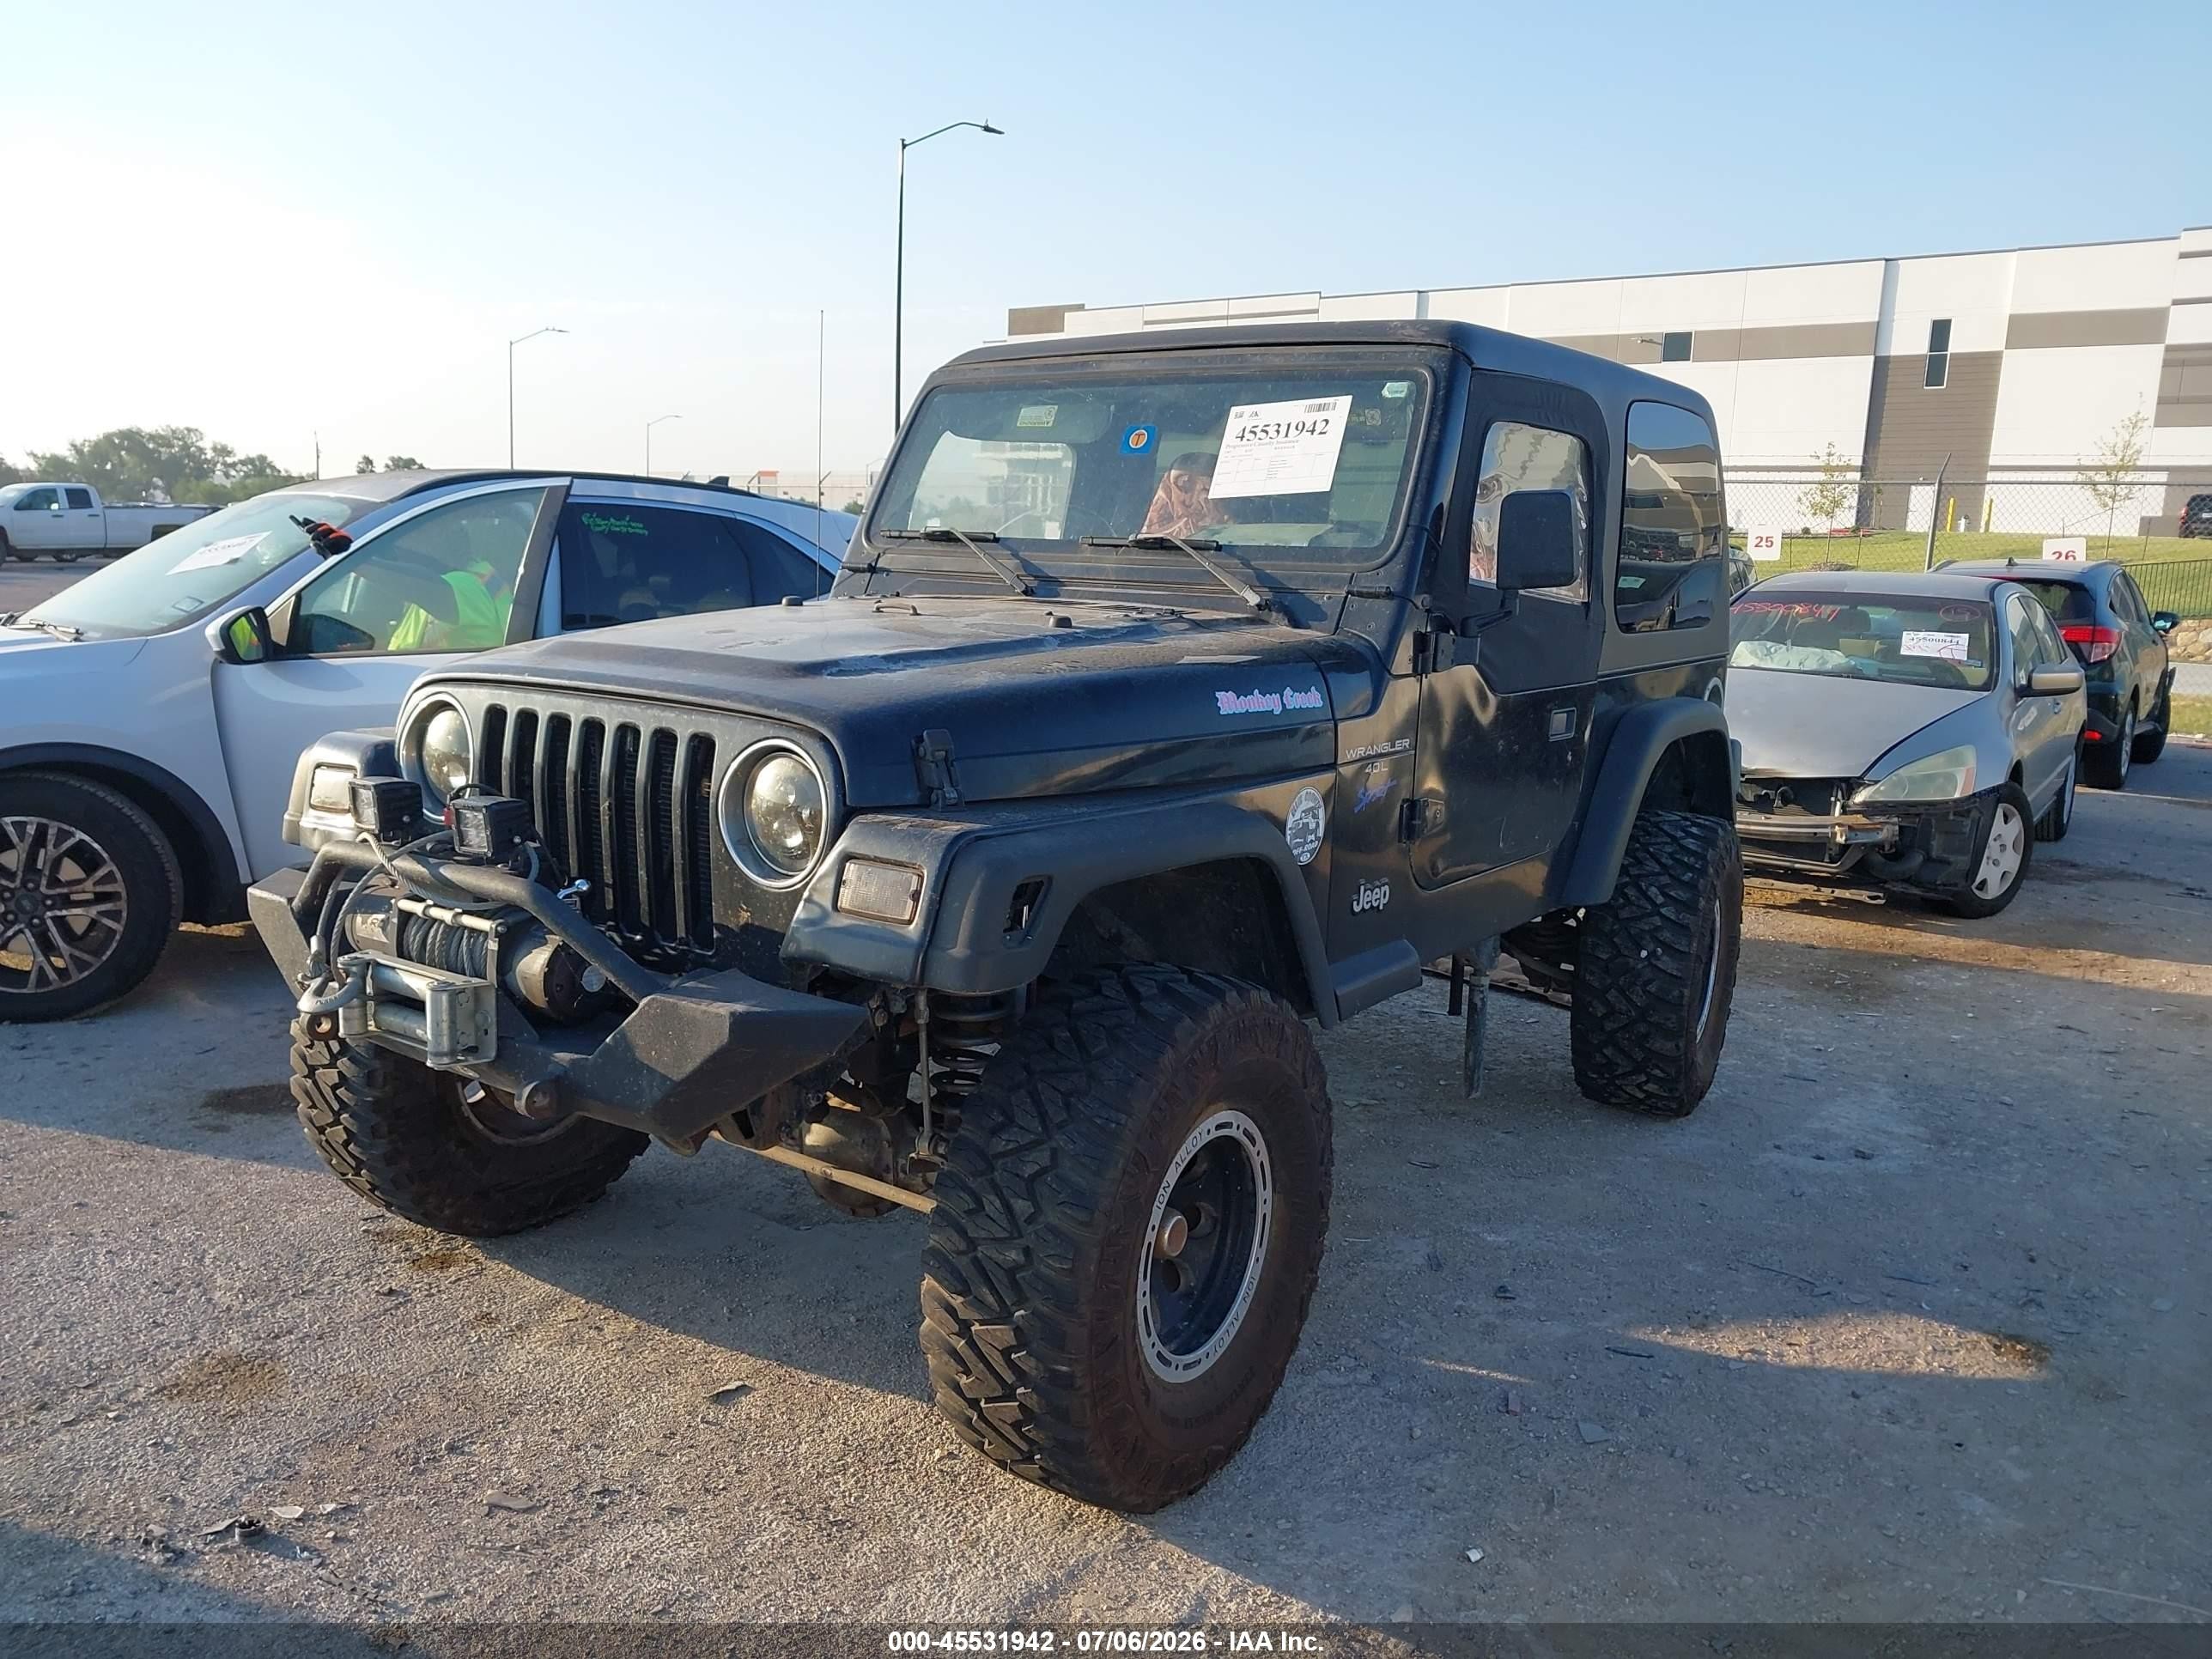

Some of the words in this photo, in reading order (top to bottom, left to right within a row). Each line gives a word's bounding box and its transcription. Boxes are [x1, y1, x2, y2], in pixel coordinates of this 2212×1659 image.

[1235, 418, 1329, 442] 45531942
[1754, 536, 1774, 548] 25
[1346, 738, 1410, 759] WRANGLER
[1352, 884, 1390, 913] Jeep
[1156, 1180, 1170, 1210] ION
[1174, 1130, 1202, 1173] ALLOY
